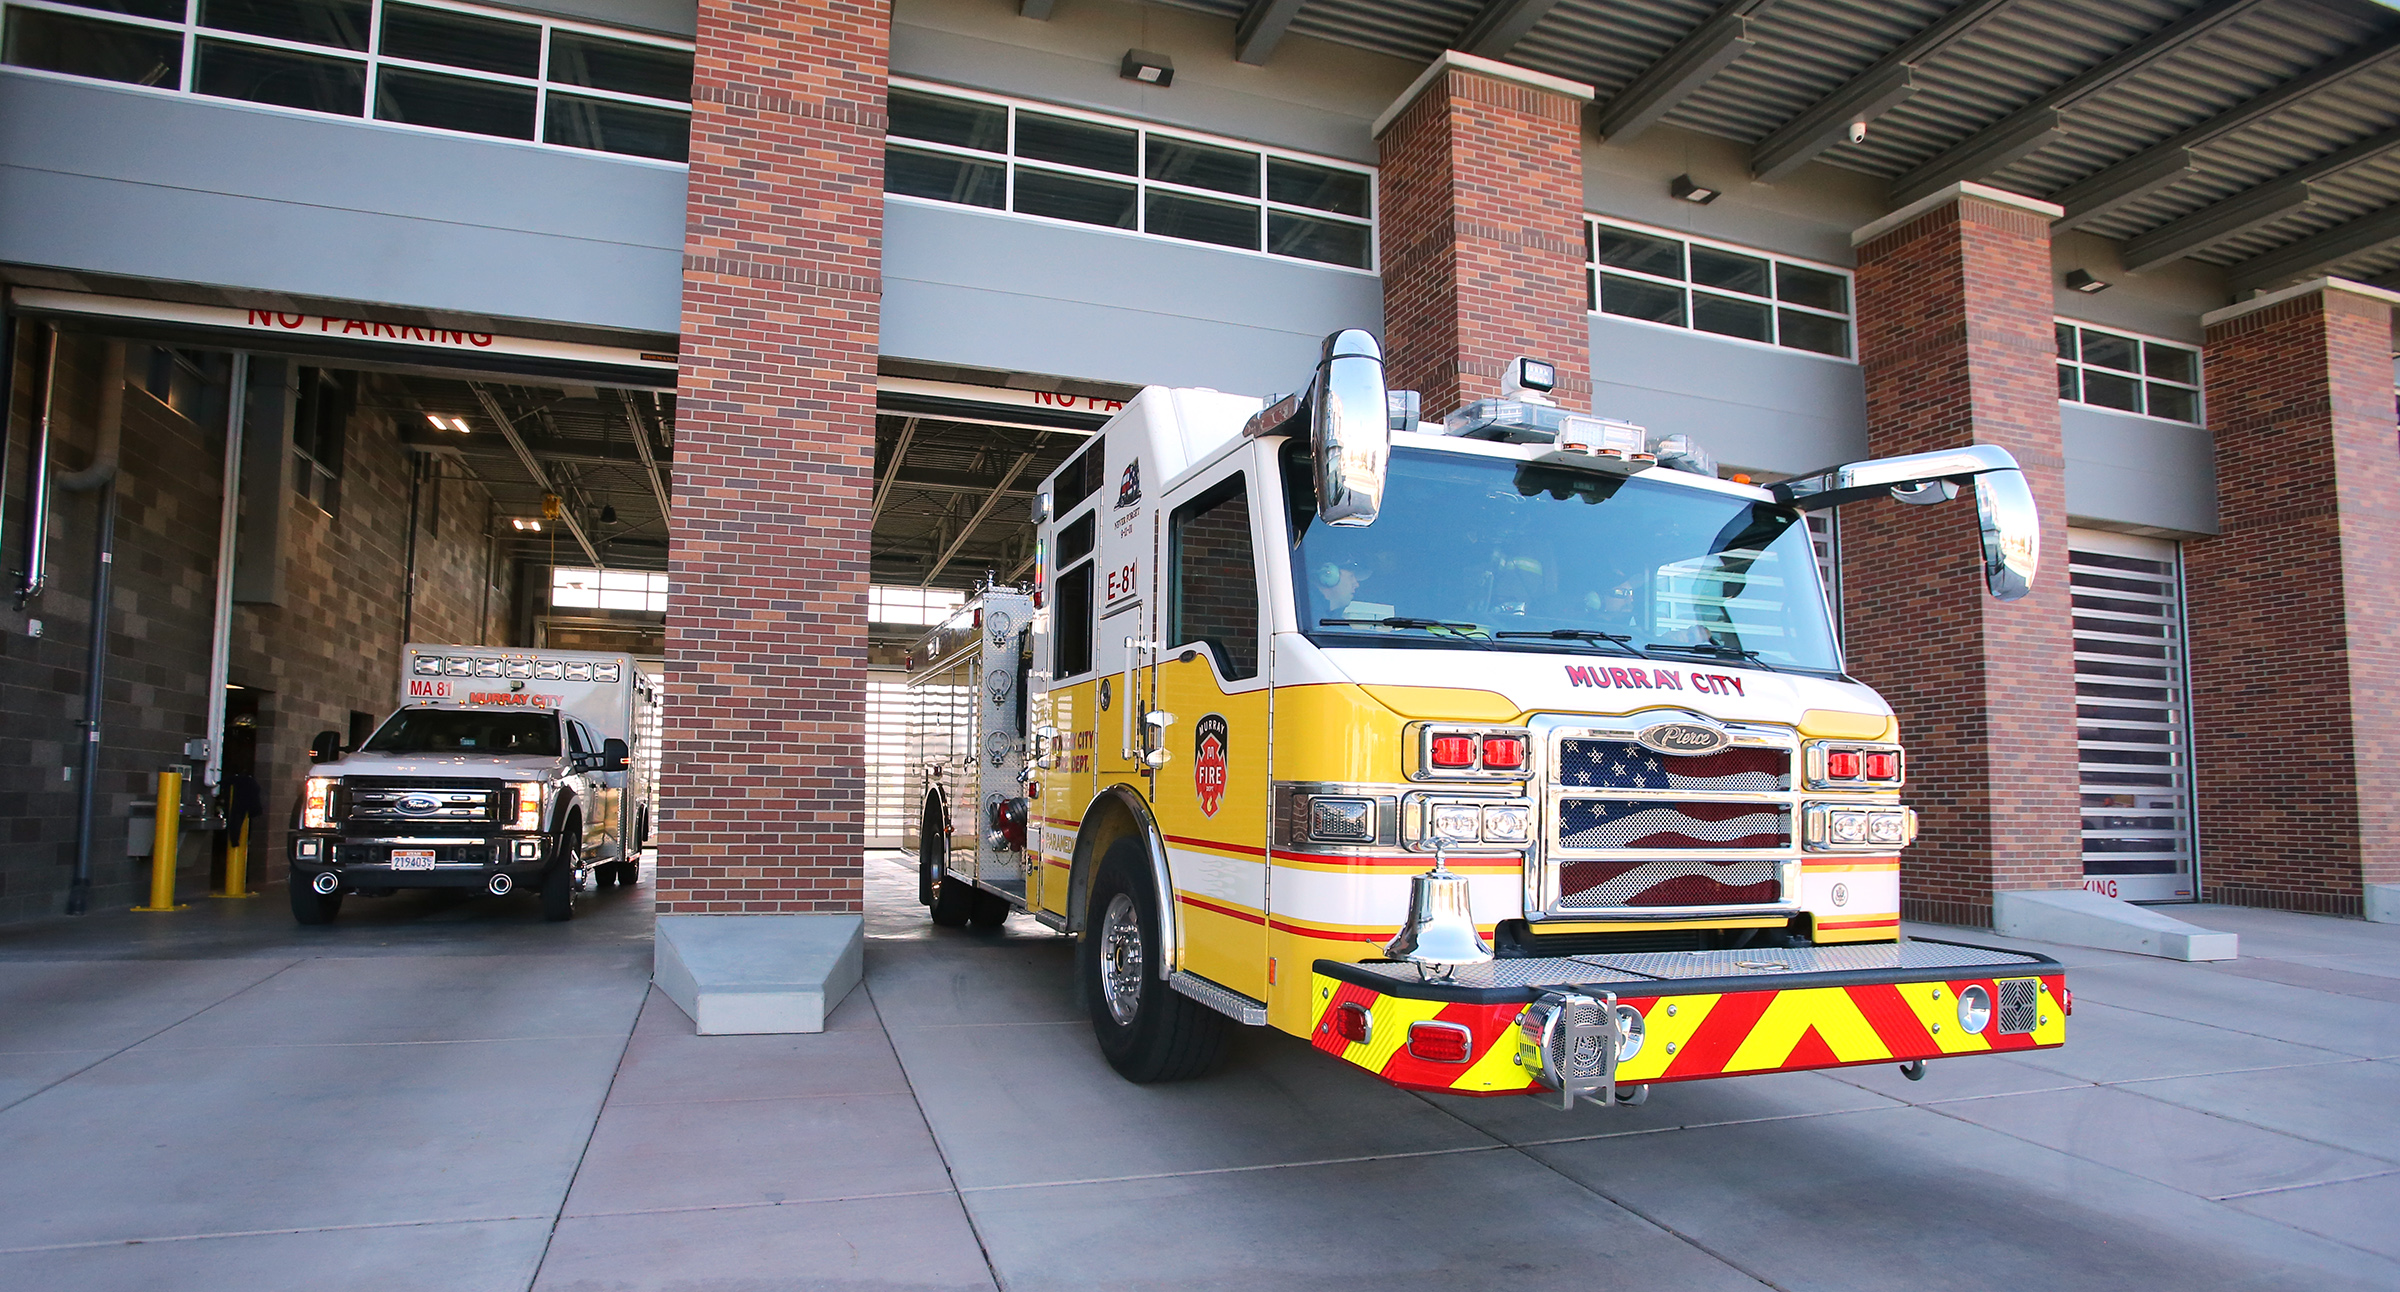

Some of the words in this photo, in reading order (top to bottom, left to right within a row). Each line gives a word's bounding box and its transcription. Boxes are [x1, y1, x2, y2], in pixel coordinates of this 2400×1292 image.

[248, 309, 304, 329] NO
[1035, 391, 1076, 408] NO
[1108, 562, 1135, 600] E-81
[410, 681, 432, 696] MA
[437, 682, 451, 696] 81
[1565, 665, 1683, 690] MURRAY
[1691, 672, 1745, 697] CITY
[469, 692, 530, 706] MURRAY
[532, 694, 564, 707] CITY
[1199, 719, 1225, 736] MURRAY
[1661, 726, 1712, 747] Pierce
[1078, 730, 1094, 749] CITY
[1199, 766, 1223, 784] FIRE
[394, 856, 427, 868] 219403
